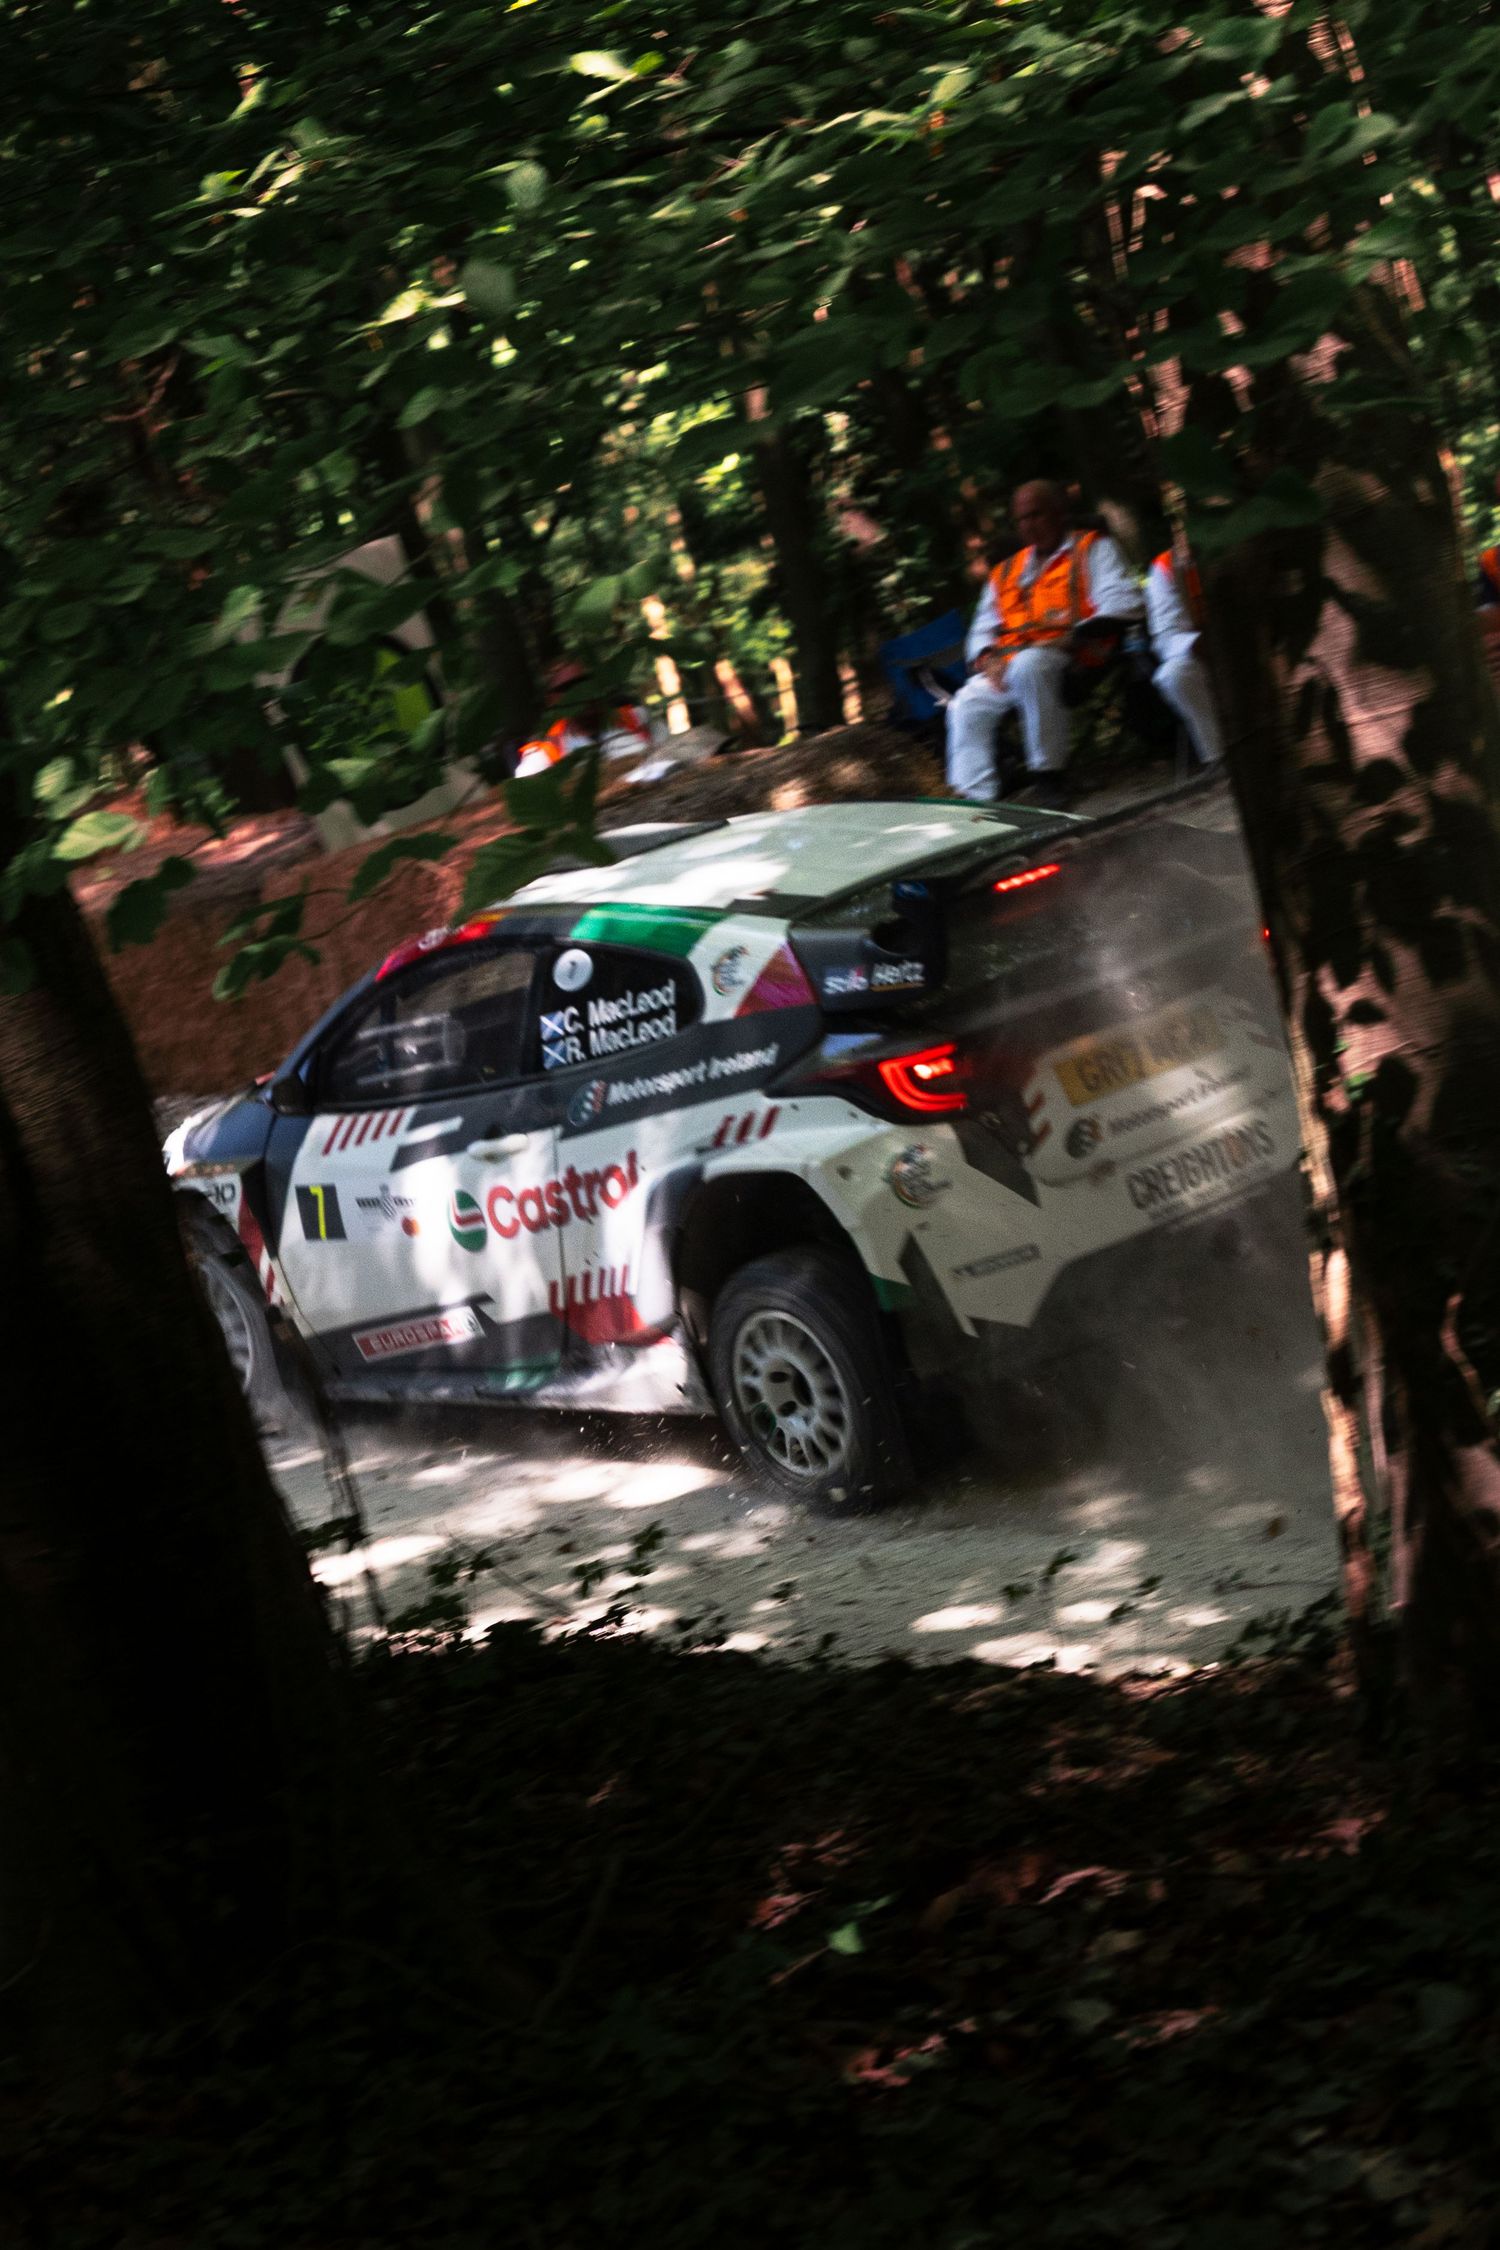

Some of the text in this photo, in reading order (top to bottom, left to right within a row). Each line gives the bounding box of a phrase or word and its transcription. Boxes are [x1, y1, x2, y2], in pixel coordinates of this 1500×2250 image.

[587, 977, 677, 1029] MacLeod
[588, 1007, 678, 1057] MacLeod
[606, 1041, 781, 1106] Motorsport Ireland
[487, 1148, 639, 1240] Castrol
